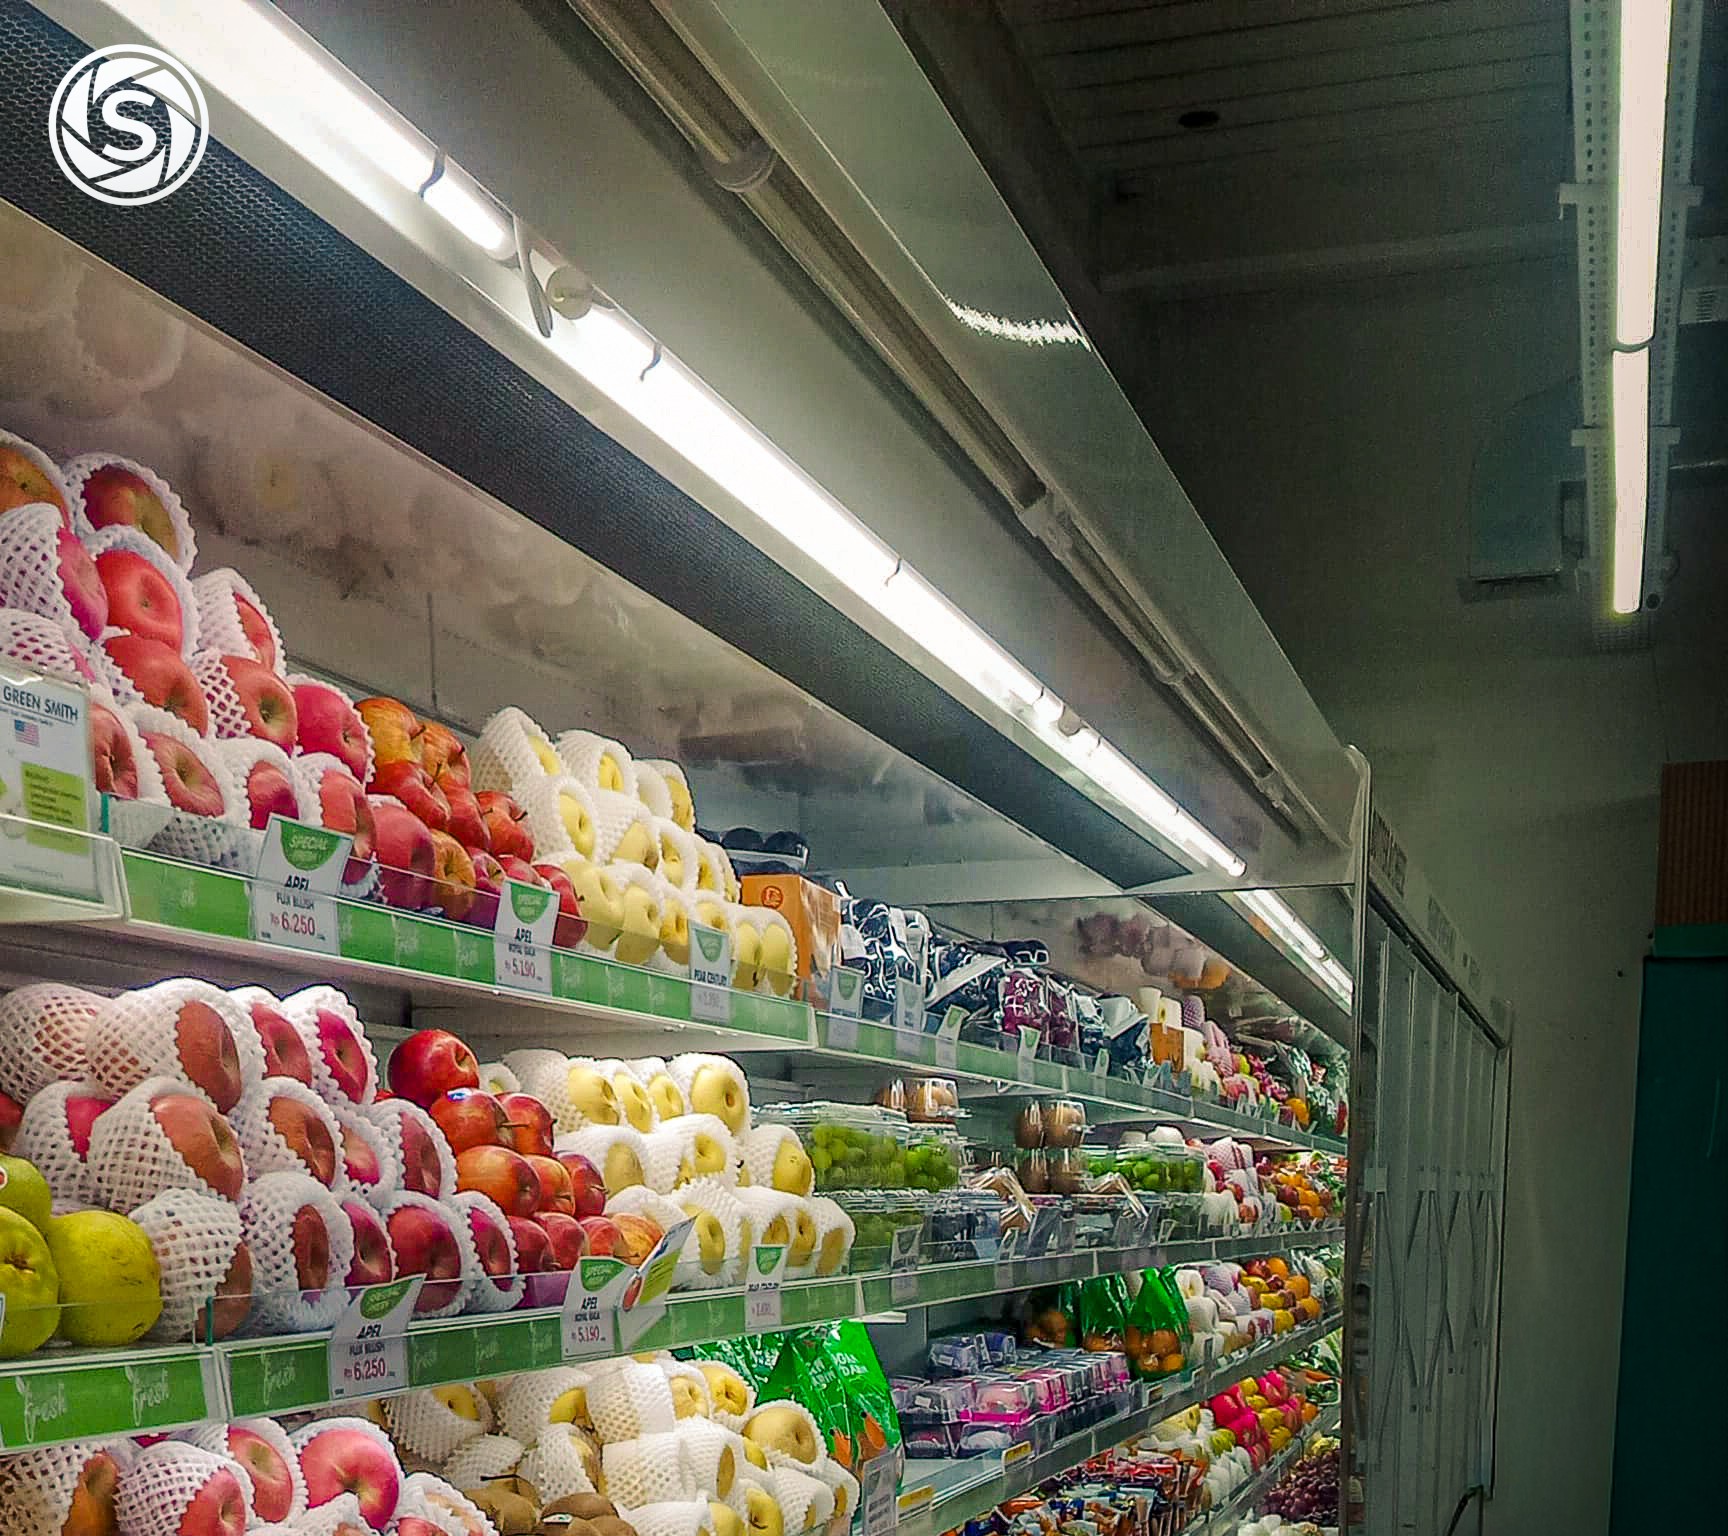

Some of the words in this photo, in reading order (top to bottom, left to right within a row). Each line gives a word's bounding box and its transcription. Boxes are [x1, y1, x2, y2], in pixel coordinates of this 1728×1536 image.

[3, 685, 41, 711] GREEN
[44, 699, 79, 722] SMITH
[281, 911, 316, 936] 6.250
[353, 1357, 387, 1381] 6.250
